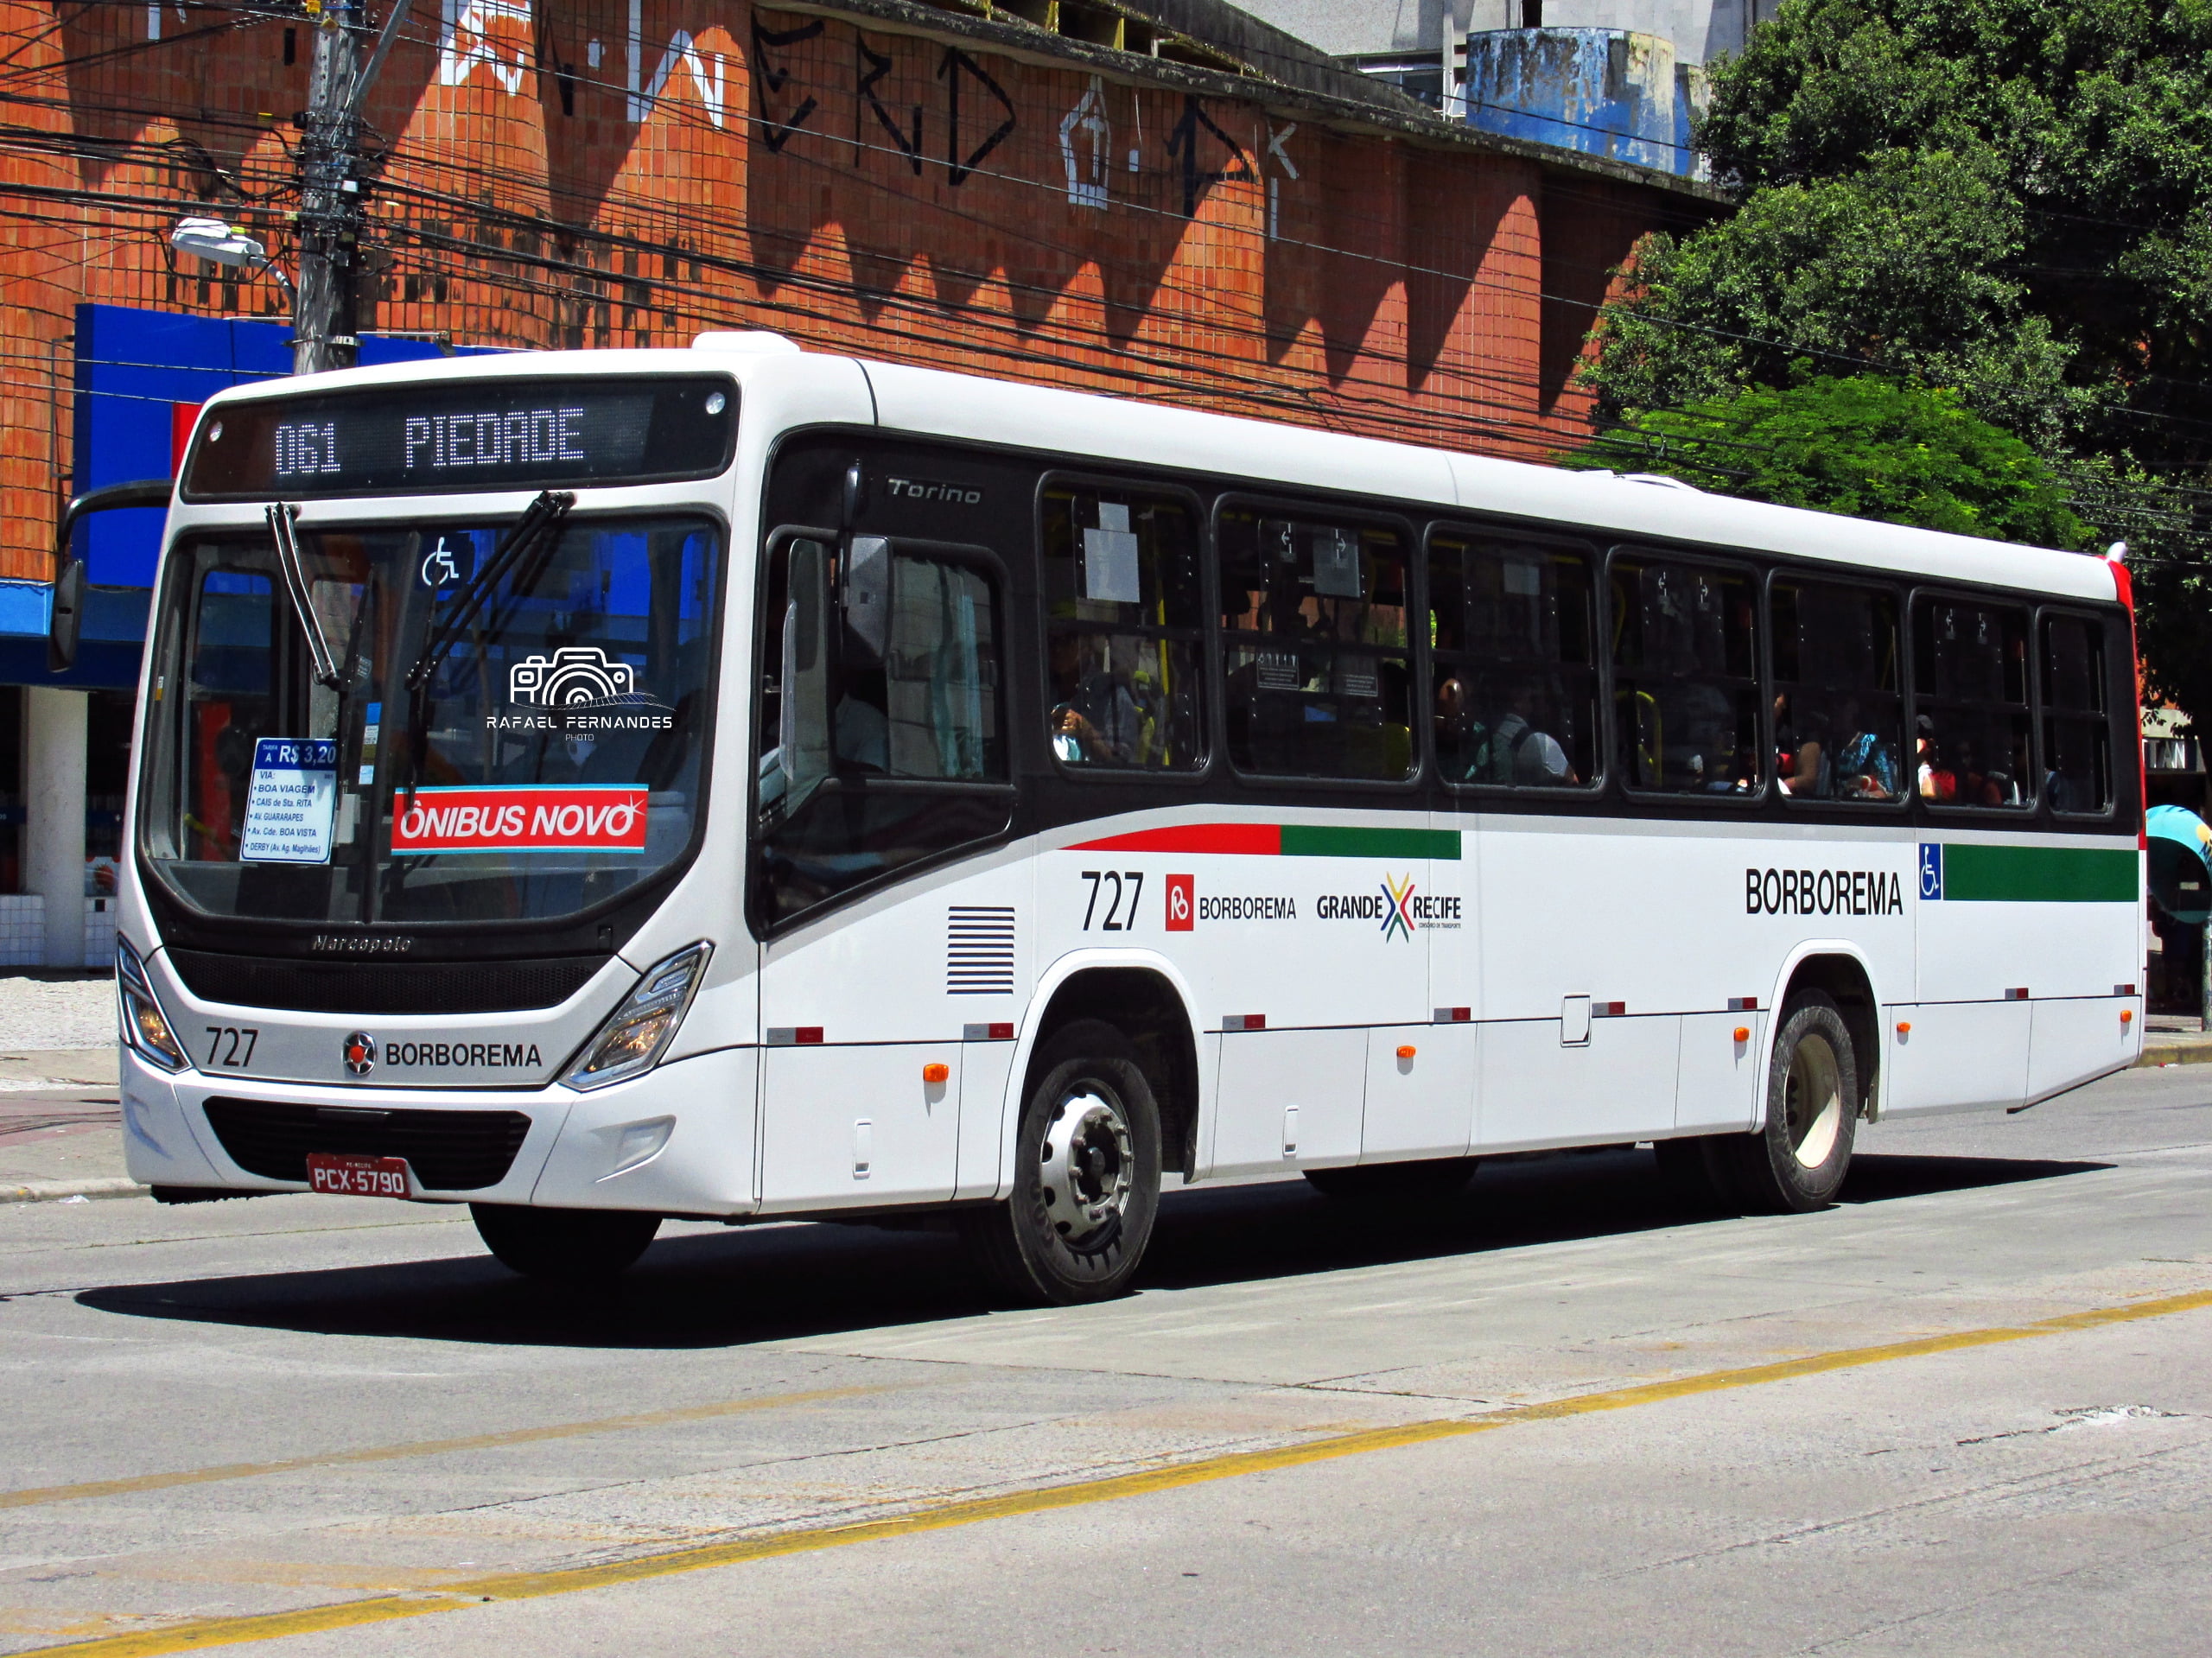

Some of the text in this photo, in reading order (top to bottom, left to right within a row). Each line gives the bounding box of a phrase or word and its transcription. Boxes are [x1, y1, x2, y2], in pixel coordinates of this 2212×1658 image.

[276, 408, 584, 474] 061 PIEDADE
[888, 478, 981, 504] Torino
[264, 753, 272, 762] A
[279, 745, 336, 766] R$ 3,20
[260, 771, 276, 779] VIA:
[280, 785, 315, 793] VIAGEM
[283, 798, 295, 807] Sta.
[264, 813, 304, 822] GUARARAPES
[400, 800, 634, 838] ÔNIBUS NOVO
[279, 828, 295, 836] BOA
[250, 842, 270, 851] DERBY
[1081, 870, 1144, 931] 727
[1746, 867, 1904, 916] BORBOREMA
[1199, 897, 1297, 920] BORBOREMA
[1317, 895, 1461, 919] GRANDE RECIFE
[312, 935, 410, 953] Marcopolo
[206, 1026, 259, 1067] 727
[385, 1043, 543, 1067] BORBOREMA
